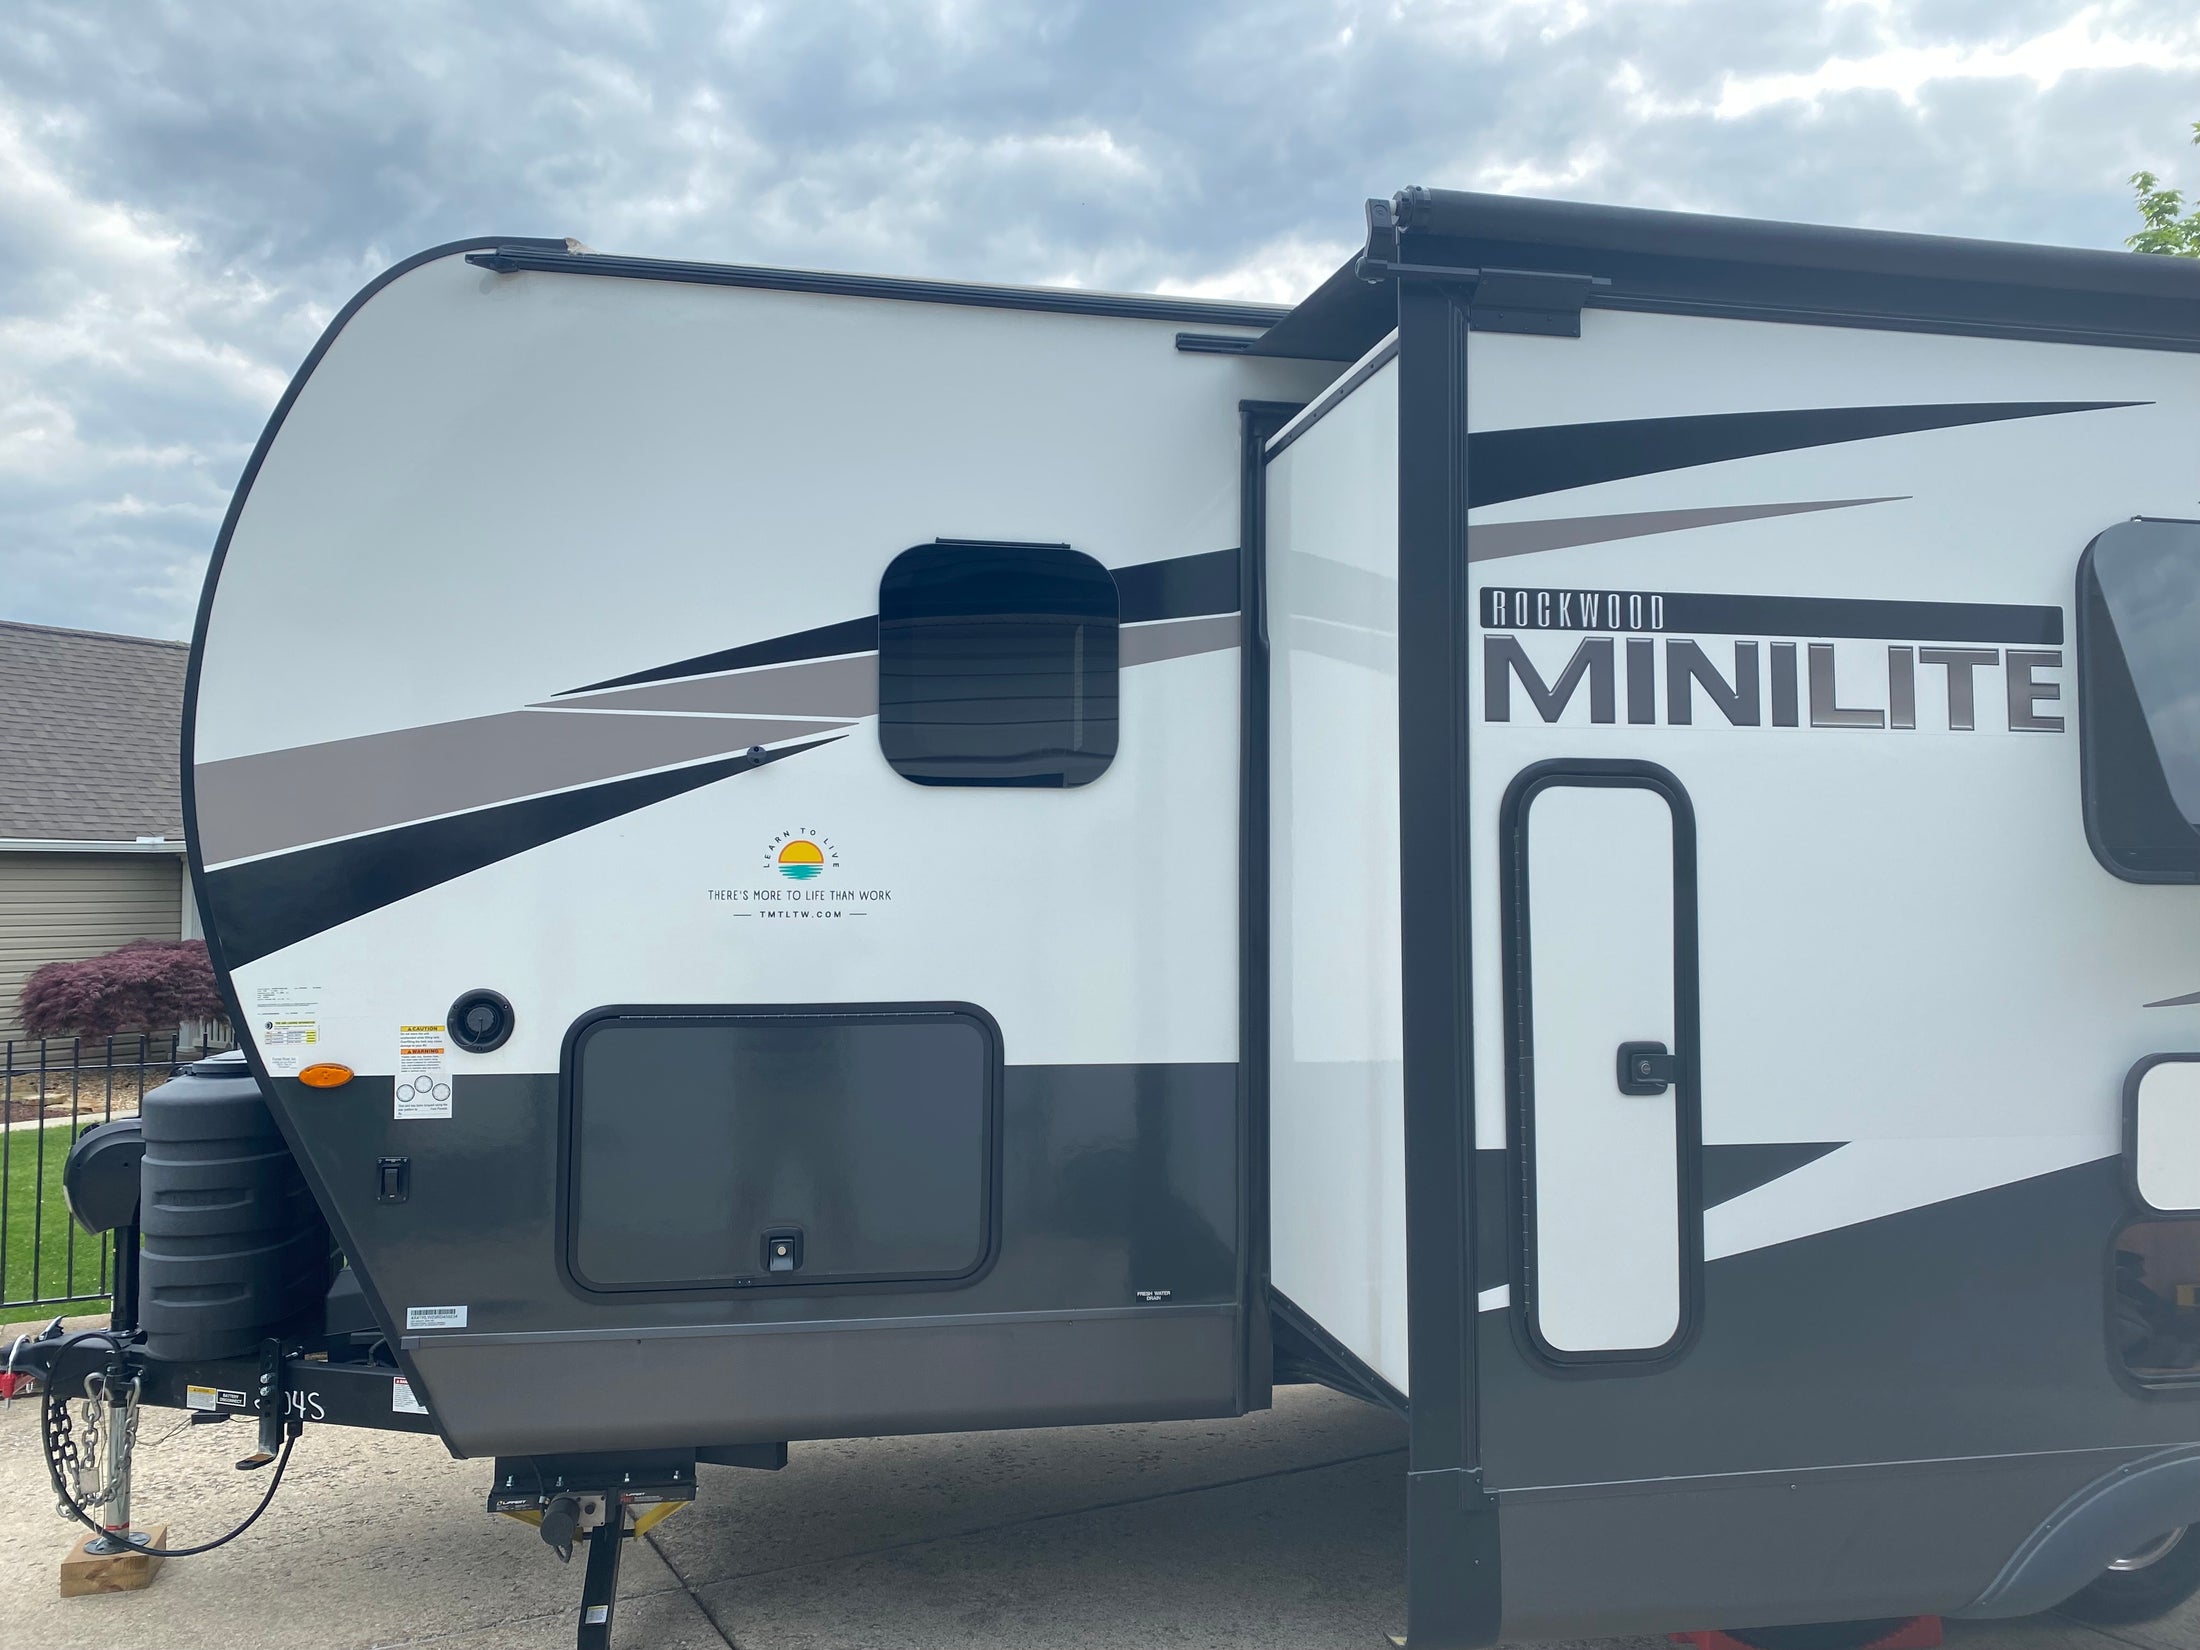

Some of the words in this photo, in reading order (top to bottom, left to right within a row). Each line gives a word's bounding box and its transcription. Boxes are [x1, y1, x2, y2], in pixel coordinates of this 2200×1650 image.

[1492, 590, 1665, 630] ROCKWOOD
[1483, 634, 2066, 733] MINILITE
[763, 830, 791, 868] LEARN
[800, 828, 816, 836] TO
[823, 838, 840, 868] LIVE
[708, 889, 749, 901] THERE'S
[753, 889, 782, 901] MORE
[786, 889, 801, 901] TO
[805, 889, 825, 901] LIFE
[830, 889, 855, 901] THAN
[859, 889, 892, 901] WORK
